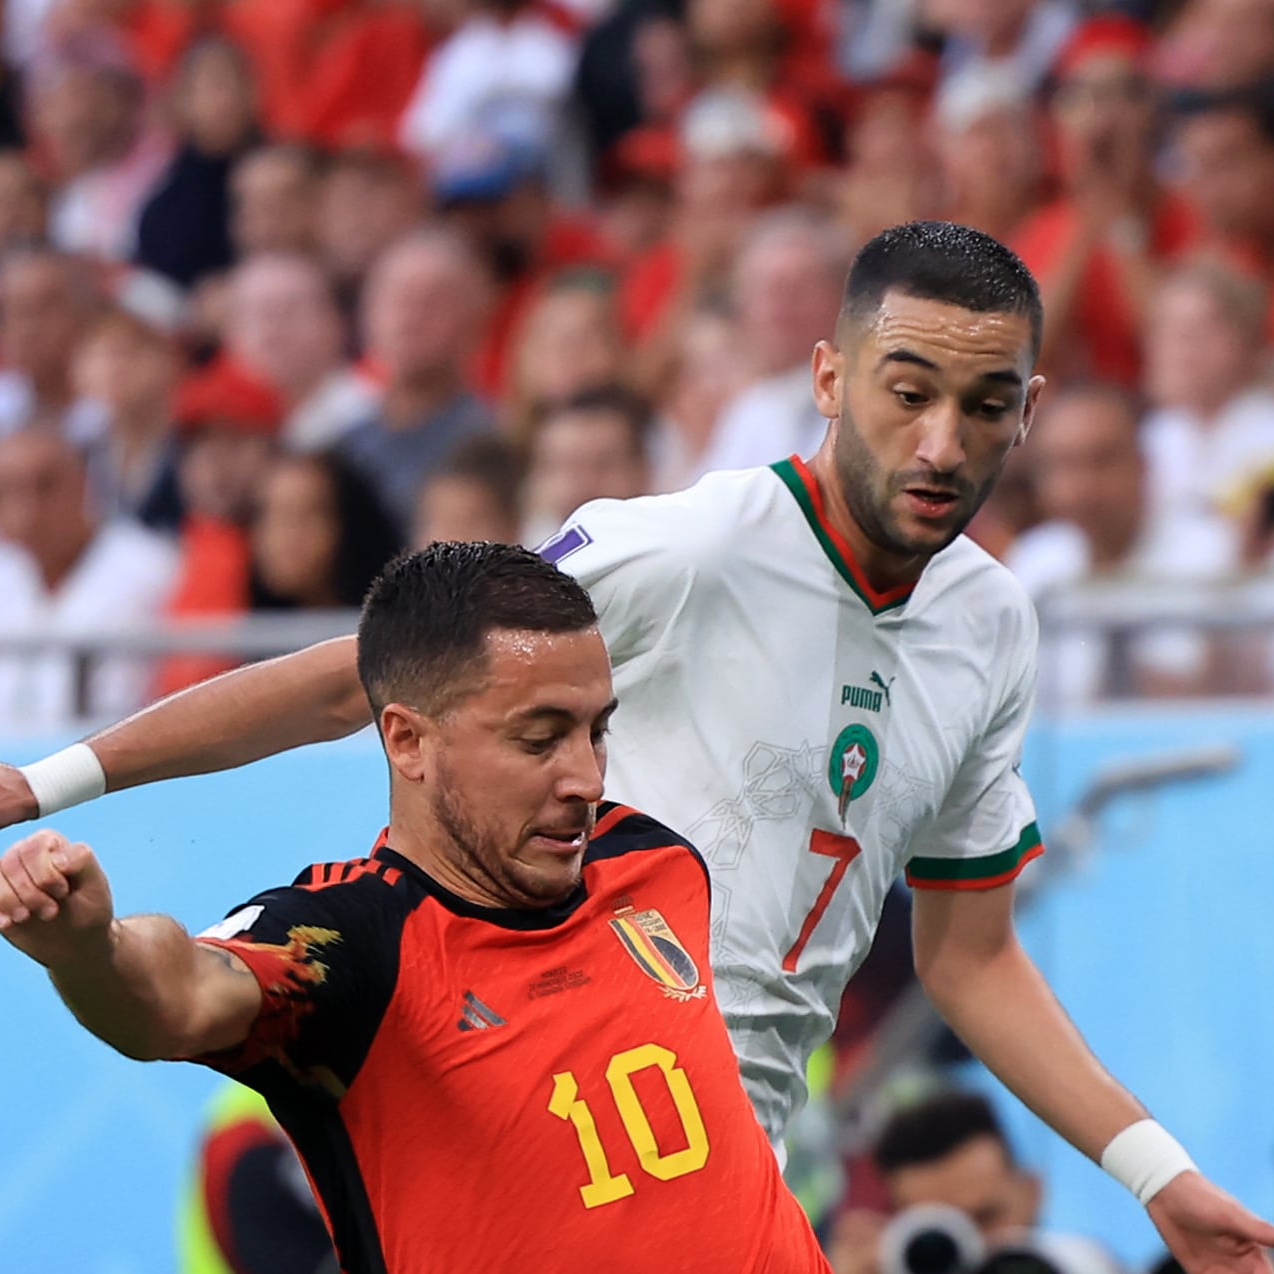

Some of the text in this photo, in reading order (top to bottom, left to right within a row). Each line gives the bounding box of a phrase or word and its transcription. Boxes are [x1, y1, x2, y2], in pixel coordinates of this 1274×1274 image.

[840, 684, 883, 713] PUMA
[782, 827, 863, 973] 7
[547, 1043, 711, 1209] 10
